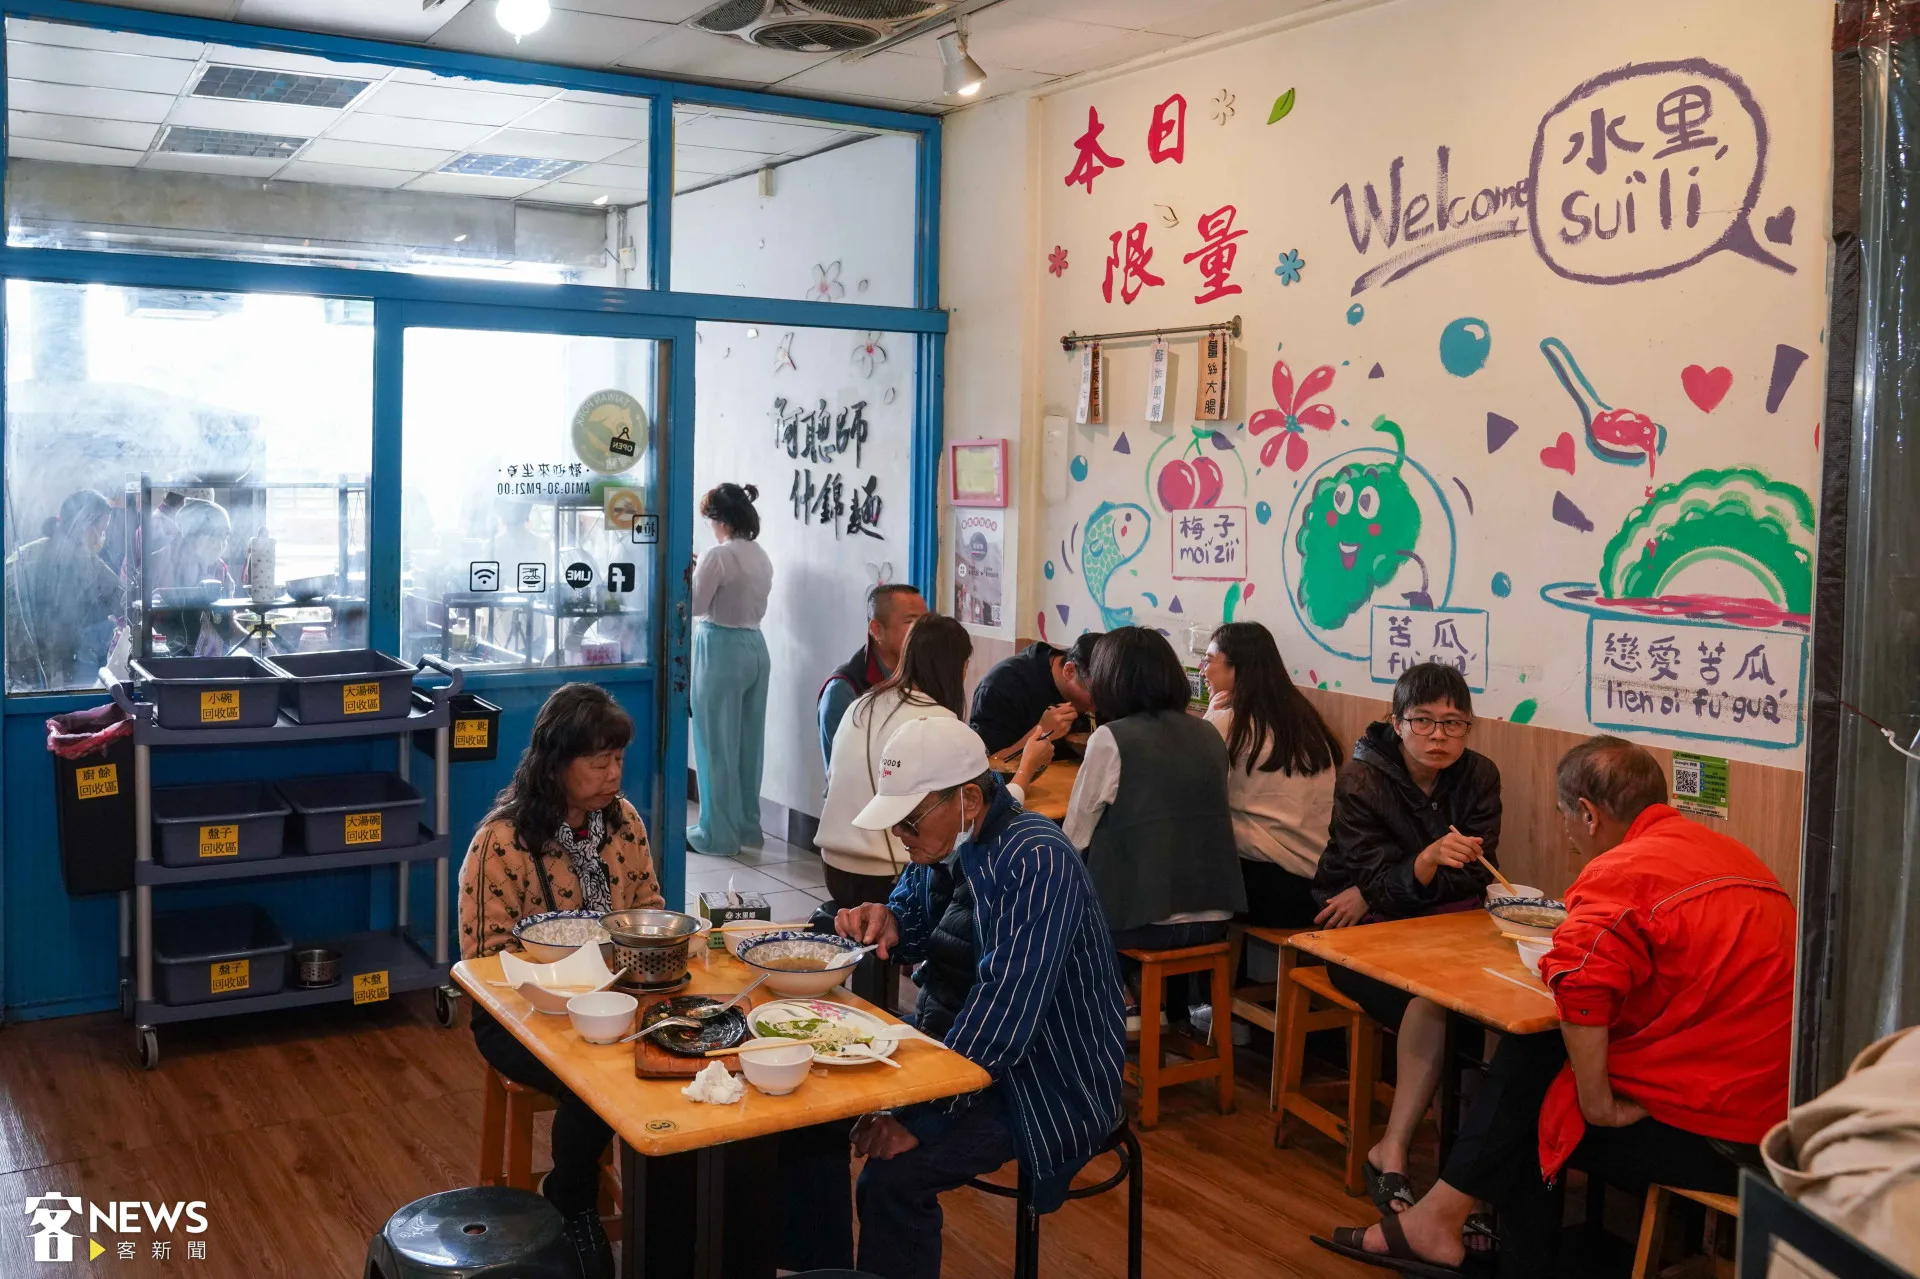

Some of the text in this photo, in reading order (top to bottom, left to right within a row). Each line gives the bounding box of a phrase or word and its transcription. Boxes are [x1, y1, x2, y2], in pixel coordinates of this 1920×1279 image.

[1563, 85, 1718, 174] 水里
[1065, 94, 1187, 194] 本日
[1330, 145, 1529, 255] Welcome
[1102, 205, 1249, 305] 限量
[1180, 514, 1235, 541] 梅子
[1388, 615, 1469, 654] 苦瓜
[1603, 632, 1776, 686] 戀愛苦瓜
[345, 684, 379, 697] 大湯碗
[208, 693, 233, 704] 小碗
[345, 698, 379, 712] 回收區
[202, 707, 238, 720] 回收區
[456, 735, 487, 746] 回收區
[80, 781, 118, 796] 回收區
[347, 814, 381, 827] 大湯碗
[207, 827, 232, 839] 盤子
[346, 829, 381, 842] 回收區
[201, 841, 237, 855] 回收區
[218, 962, 243, 975] 盤子
[212, 976, 247, 989] 回收區
[361, 974, 382, 986] 木盤
[354, 987, 388, 1001] 回收區
